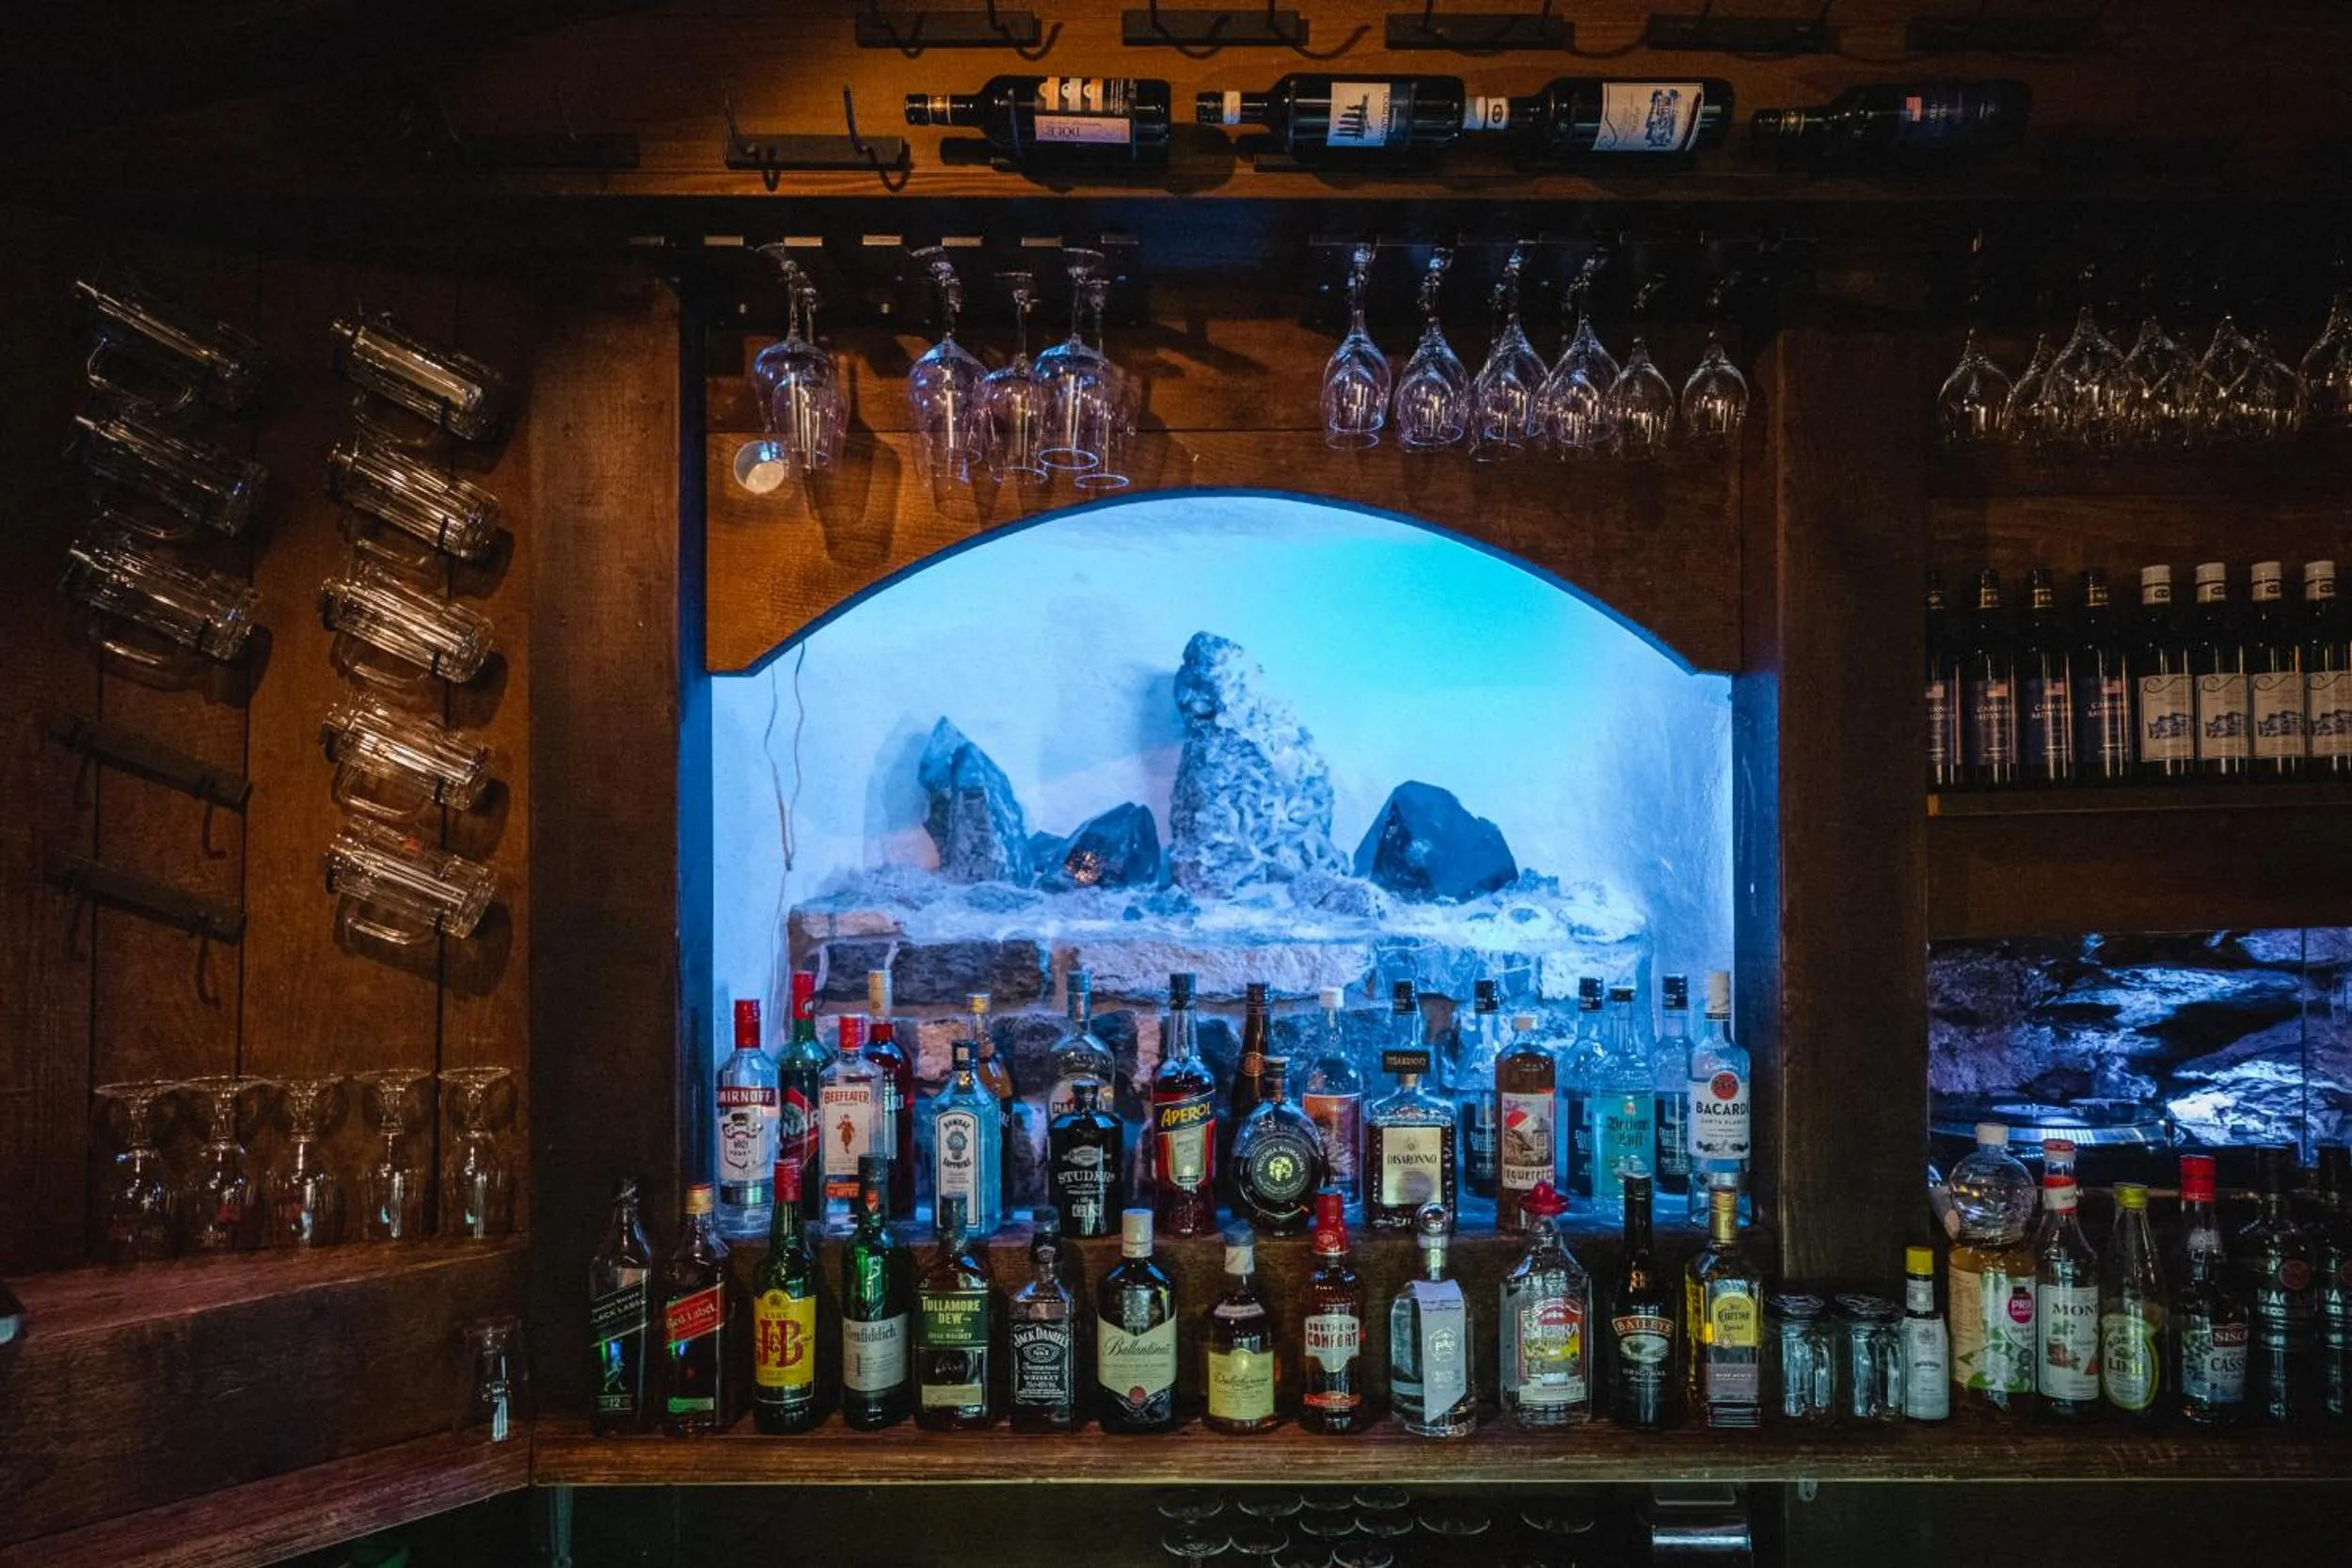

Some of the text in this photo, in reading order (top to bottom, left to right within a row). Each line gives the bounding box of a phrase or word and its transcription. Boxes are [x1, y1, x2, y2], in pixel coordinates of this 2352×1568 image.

[718, 1090, 775, 1103] MIRNOFF
[824, 1090, 870, 1104] BEEFEATER
[783, 1110, 821, 1139] NAR
[1387, 1153, 1438, 1165] DISARONNO
[923, 1297, 981, 1312] TULLAMORE
[2052, 1303, 2098, 1316] MON
[939, 1313, 961, 1324] DEW
[1309, 1323, 1356, 1332] SOUTHERN
[1617, 1320, 1672, 1333] BAILEYS
[1013, 1328, 1035, 1348] JACK
[1308, 1334, 1357, 1348] COMFORT
[2210, 1357, 2245, 1371] CASS
